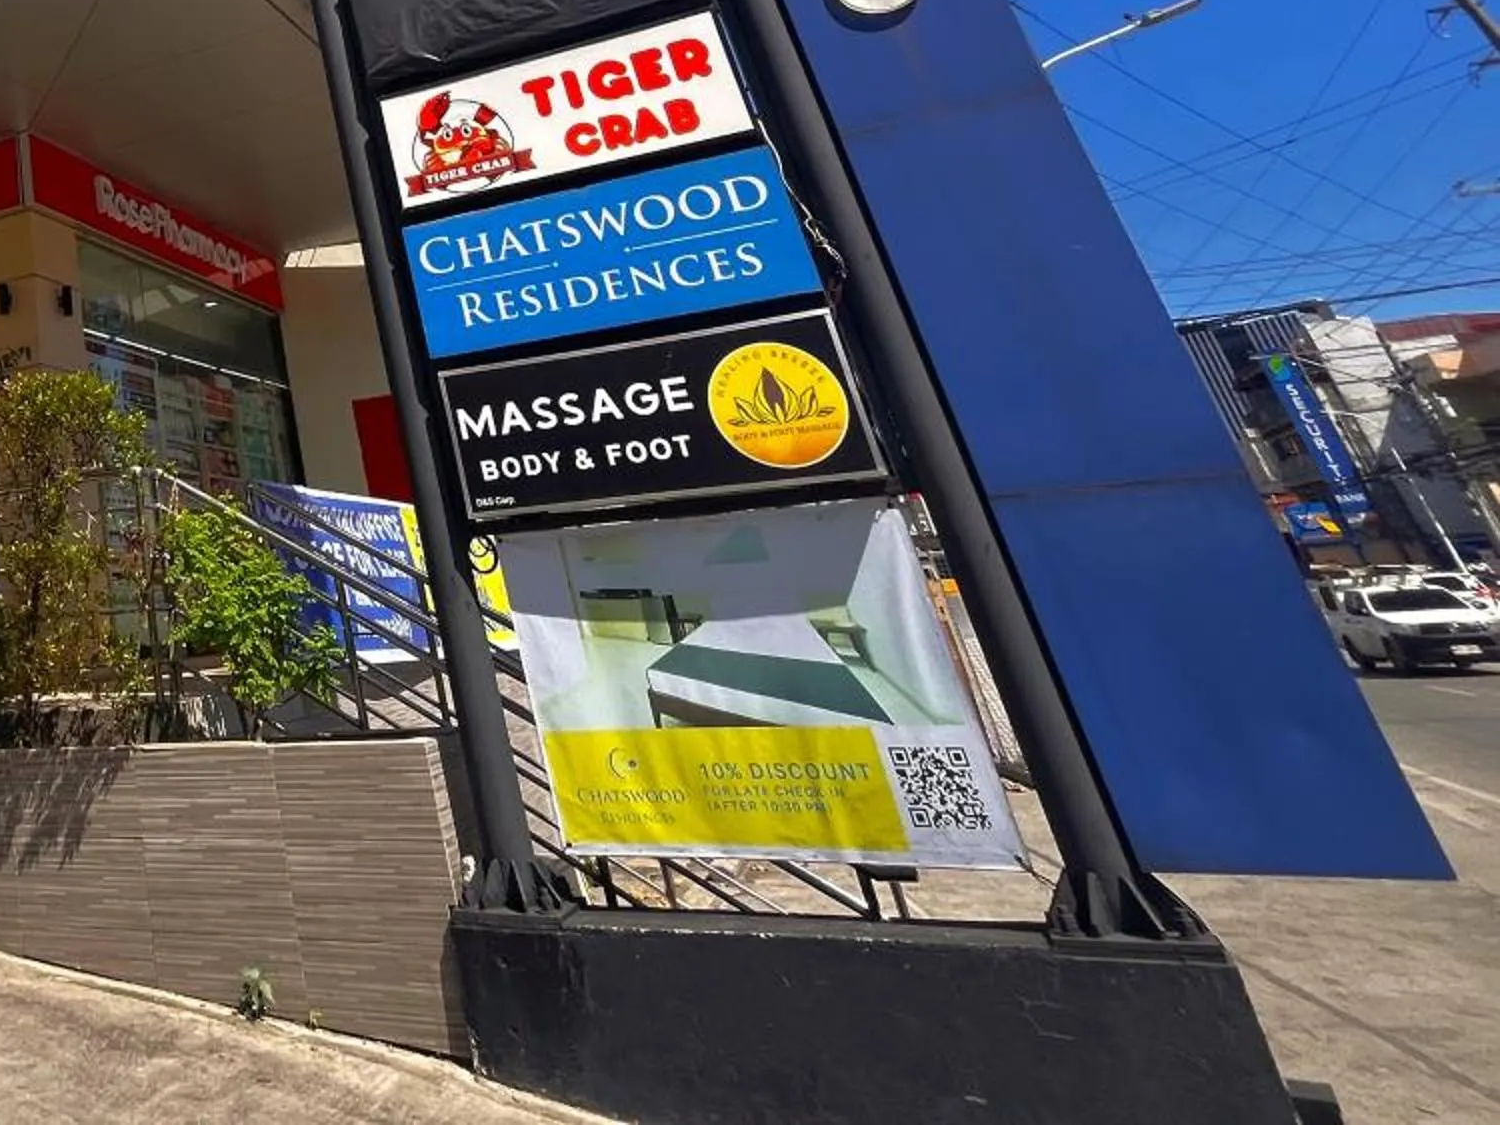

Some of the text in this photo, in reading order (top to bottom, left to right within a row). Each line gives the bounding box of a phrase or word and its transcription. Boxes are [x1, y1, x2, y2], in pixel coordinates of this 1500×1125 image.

[521, 37, 713, 117] TIGER
[564, 98, 701, 157] CRAB
[425, 156, 512, 184] TIGER CRAB
[418, 174, 769, 276] CHATSWOOD
[457, 241, 764, 328] RESIDENCES
[456, 376, 695, 441] MASSAGE
[479, 434, 692, 481] BODY & FOOT
[577, 787, 686, 805] CHATSWOOD
[699, 762, 870, 781] 10% DISCOUNT
[702, 785, 732, 797] FOR
[734, 784, 768, 797] LATE
[774, 784, 824, 798] CHECK
